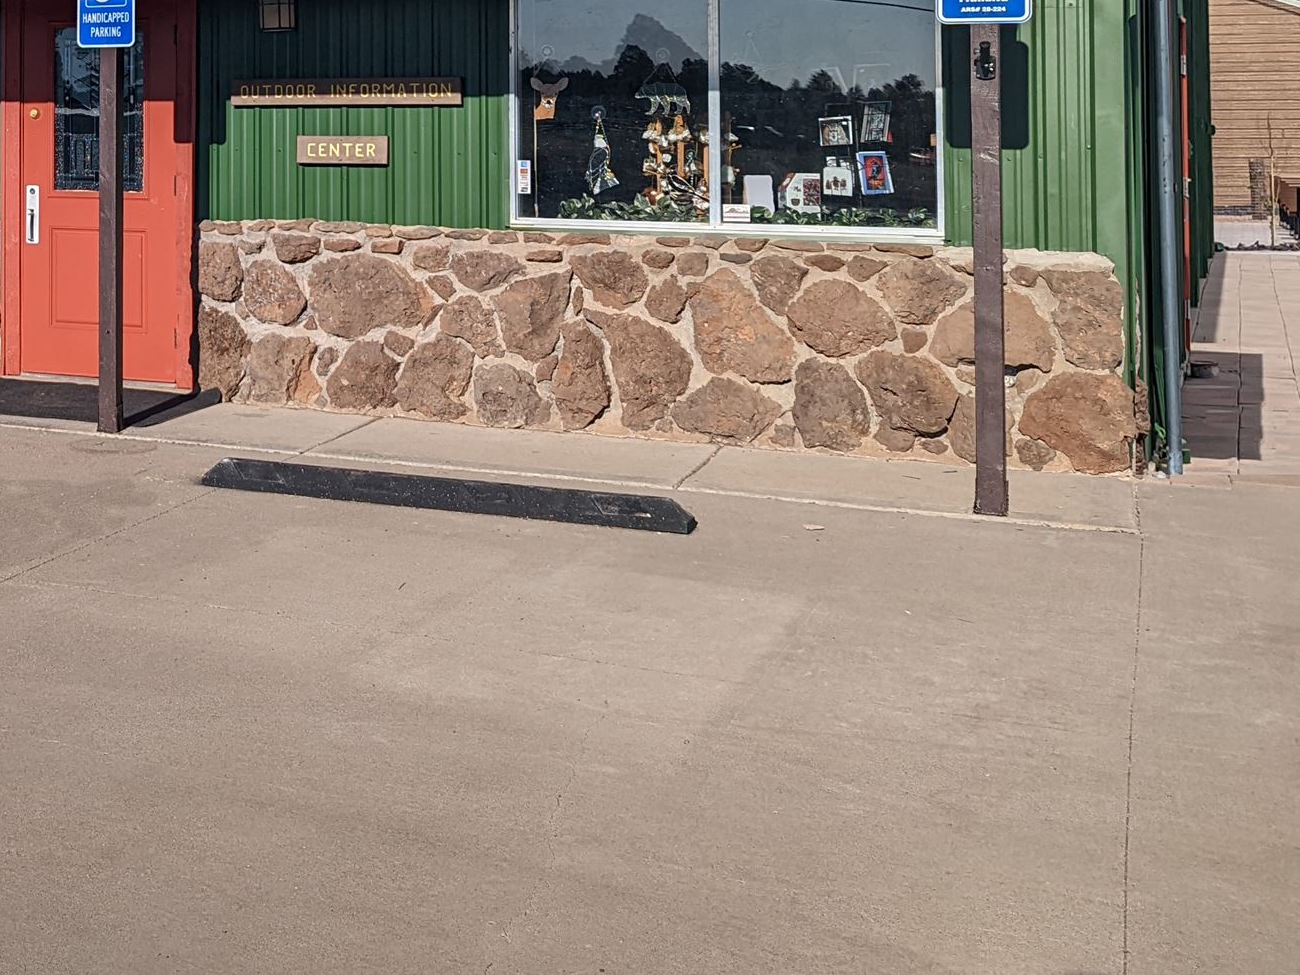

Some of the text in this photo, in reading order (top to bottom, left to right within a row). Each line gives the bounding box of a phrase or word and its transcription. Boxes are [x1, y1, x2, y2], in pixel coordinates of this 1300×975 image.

[82, 11, 130, 24] HANDICAPPED
[90, 26, 122, 37] PARKING
[240, 82, 453, 99] OUTDOOR INFORMATION
[307, 142, 376, 158] CENTER
